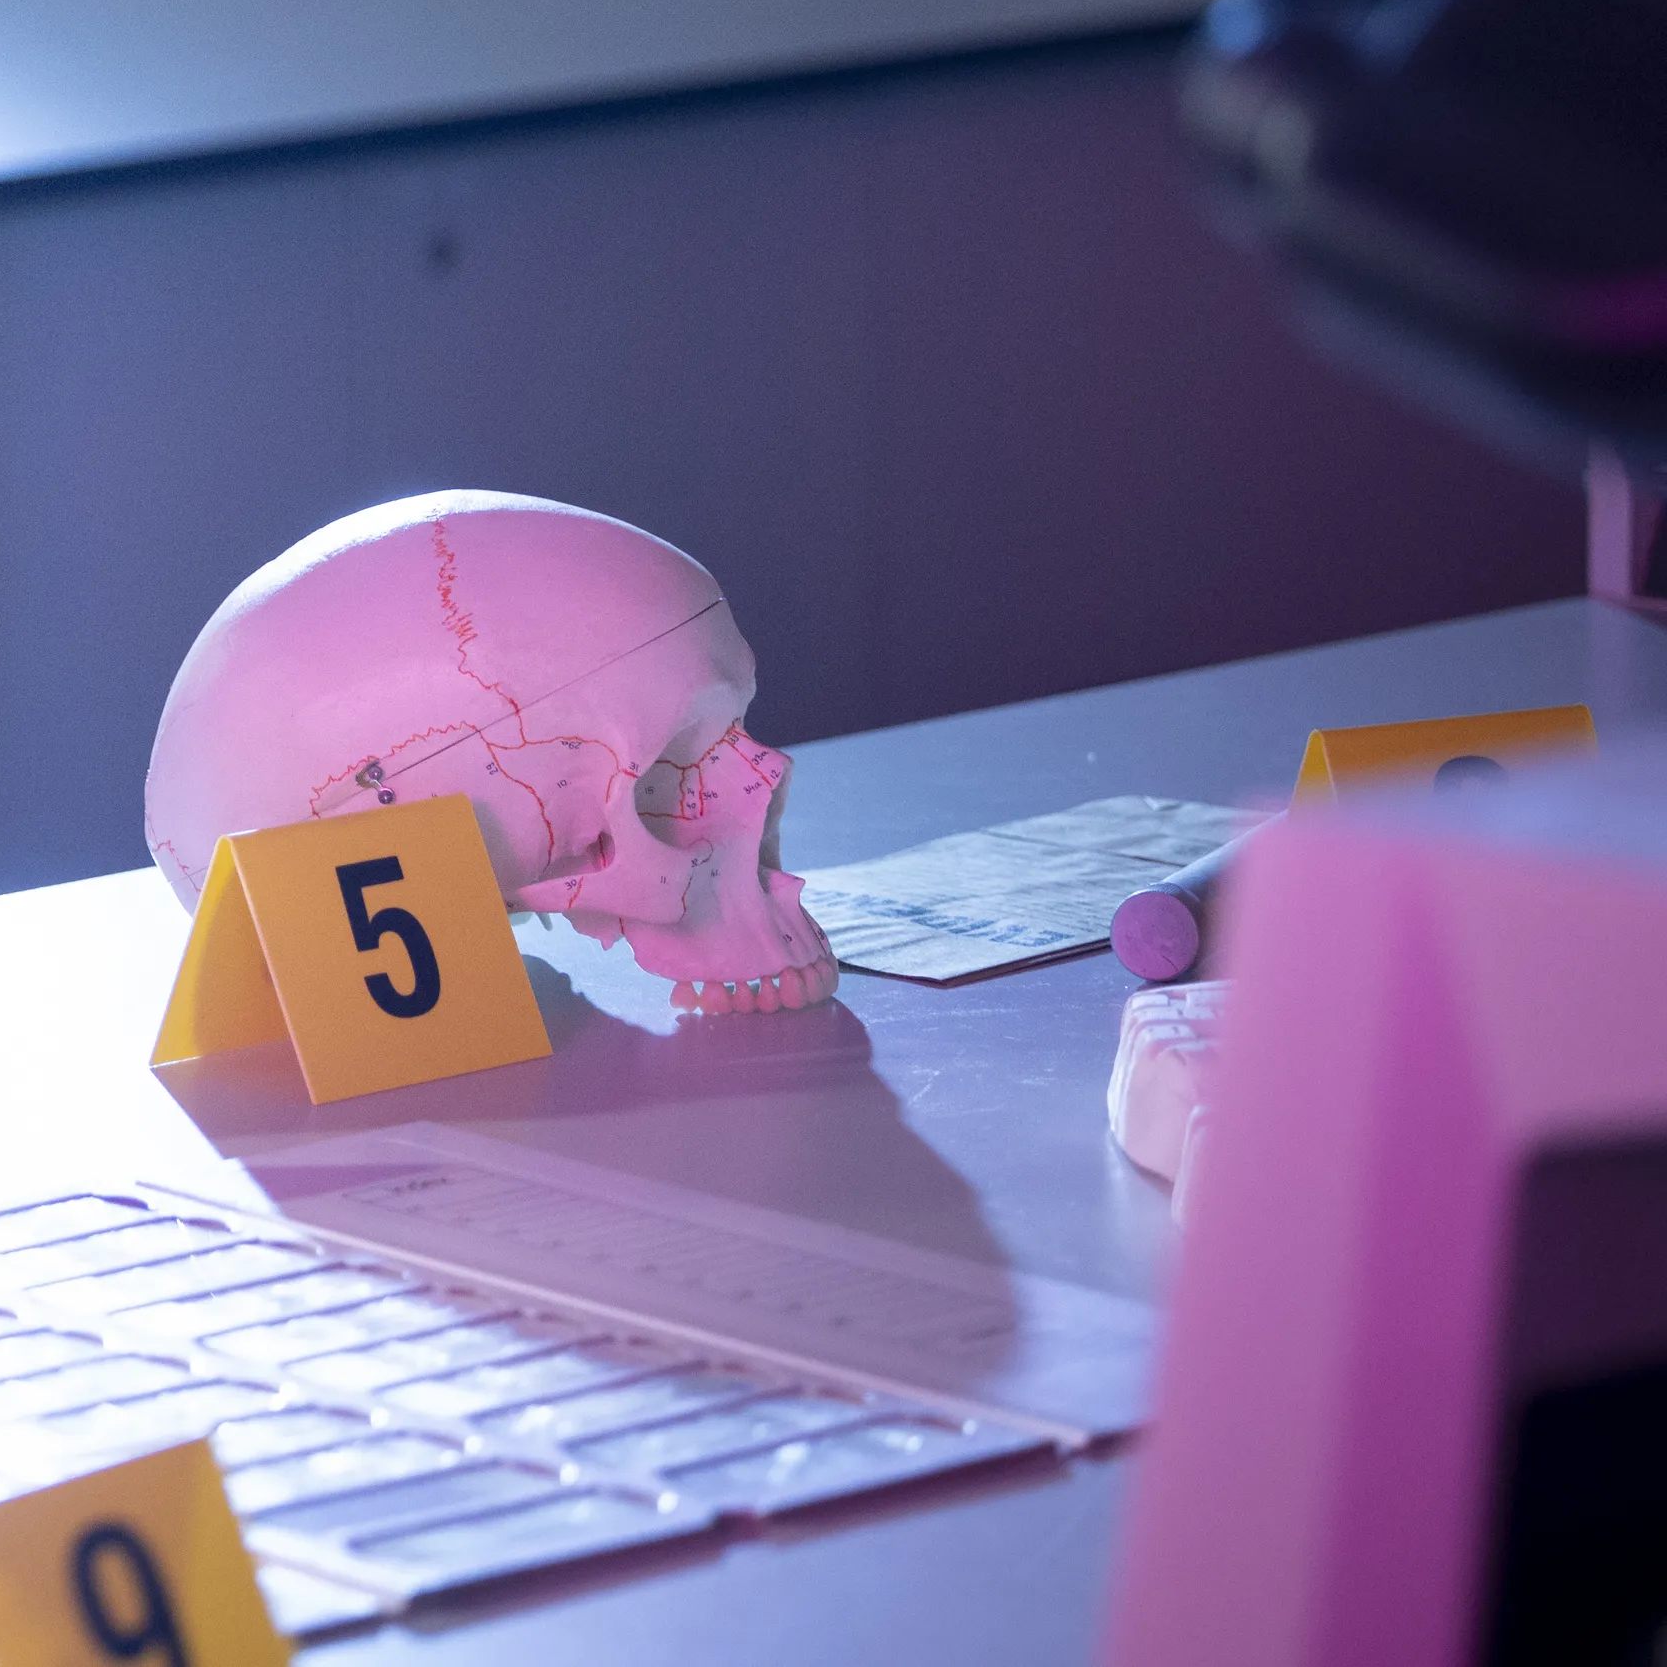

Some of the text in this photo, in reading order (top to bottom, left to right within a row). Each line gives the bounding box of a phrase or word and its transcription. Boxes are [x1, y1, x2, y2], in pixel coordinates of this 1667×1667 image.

[751, 750, 769, 766] 33a
[770, 769, 781, 780] 12
[743, 782, 763, 795] 34a
[565, 879, 578, 891] 30
[335, 855, 441, 1019] 5
[70, 1520, 191, 1667] 9
